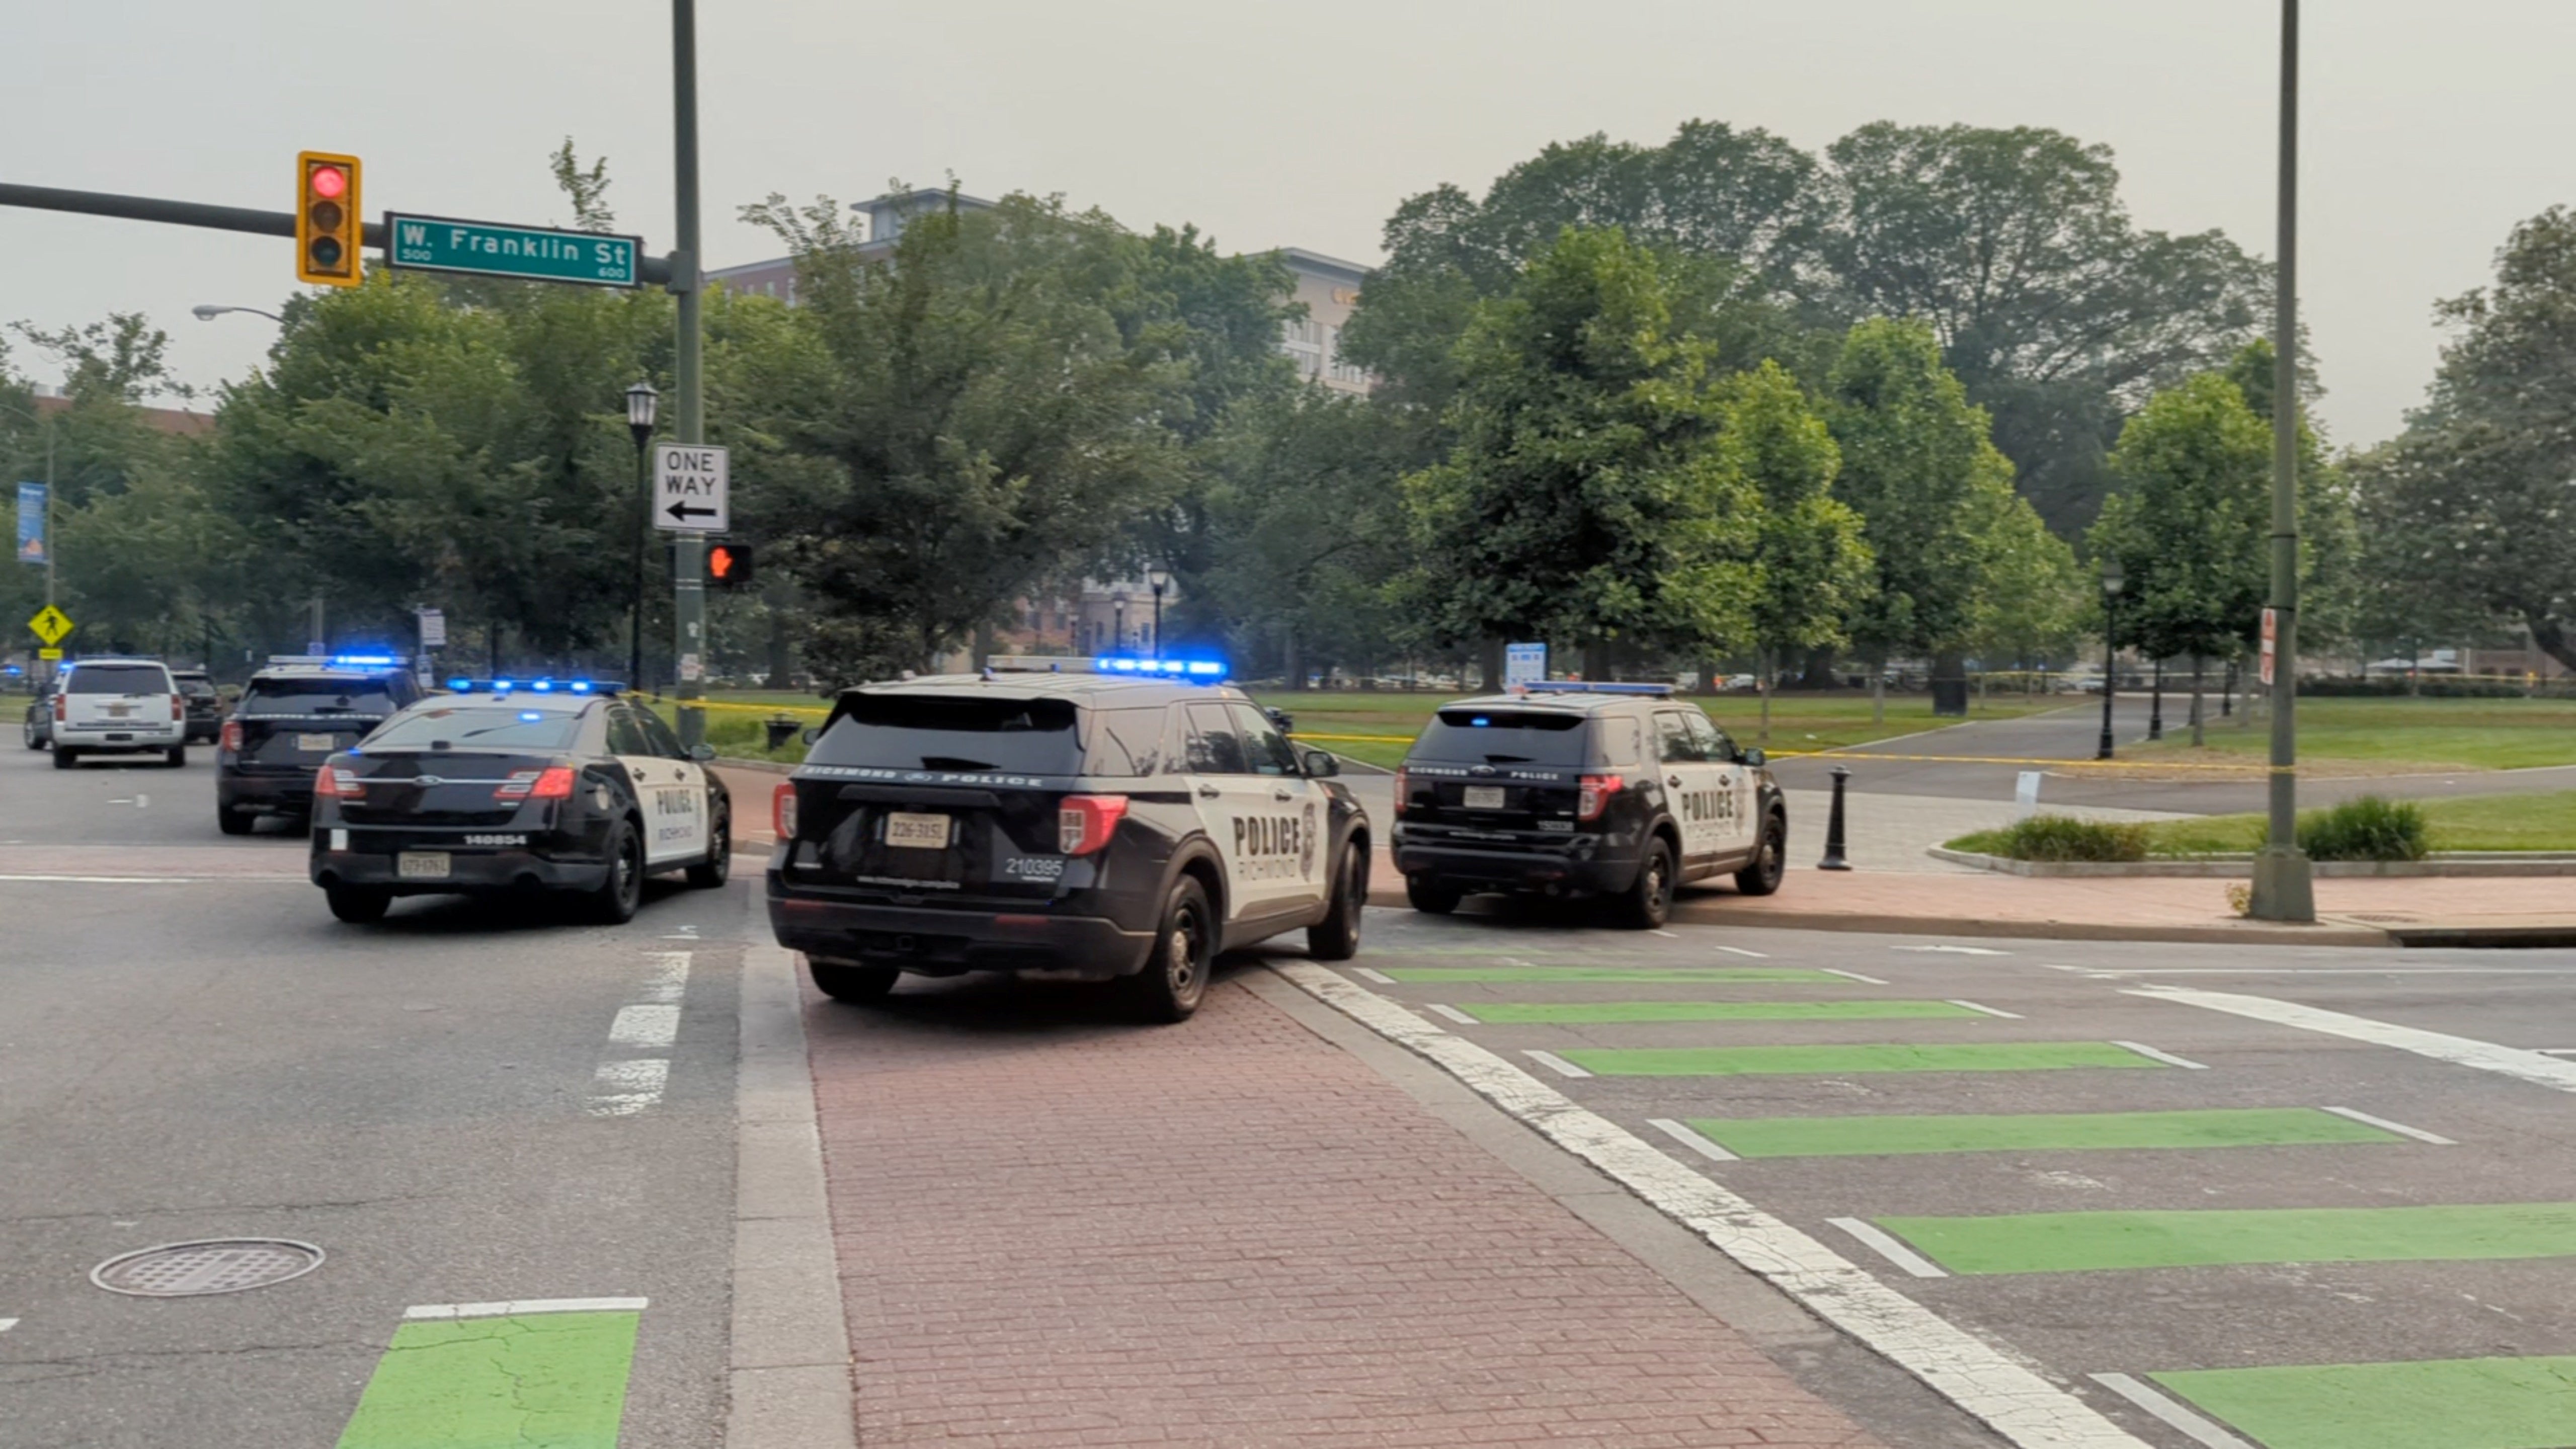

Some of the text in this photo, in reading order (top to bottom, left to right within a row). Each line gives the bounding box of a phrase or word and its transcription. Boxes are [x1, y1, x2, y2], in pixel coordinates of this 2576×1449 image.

[403, 224, 626, 266] W. Franklin St
[403, 248, 432, 261] 500
[598, 267, 626, 279] 600
[667, 451, 714, 472] ONE
[665, 475, 716, 496] WAY
[805, 766, 1043, 787] RICHMOND POLICE
[1510, 770, 1558, 780] POLICE
[656, 789, 692, 815] POLICE
[1681, 790, 1733, 822] POLICE
[463, 834, 527, 845] 140854
[1232, 816, 1300, 856] POLICE
[1006, 858, 1063, 876] 210395
[1238, 858, 1295, 881] RICHMOND
